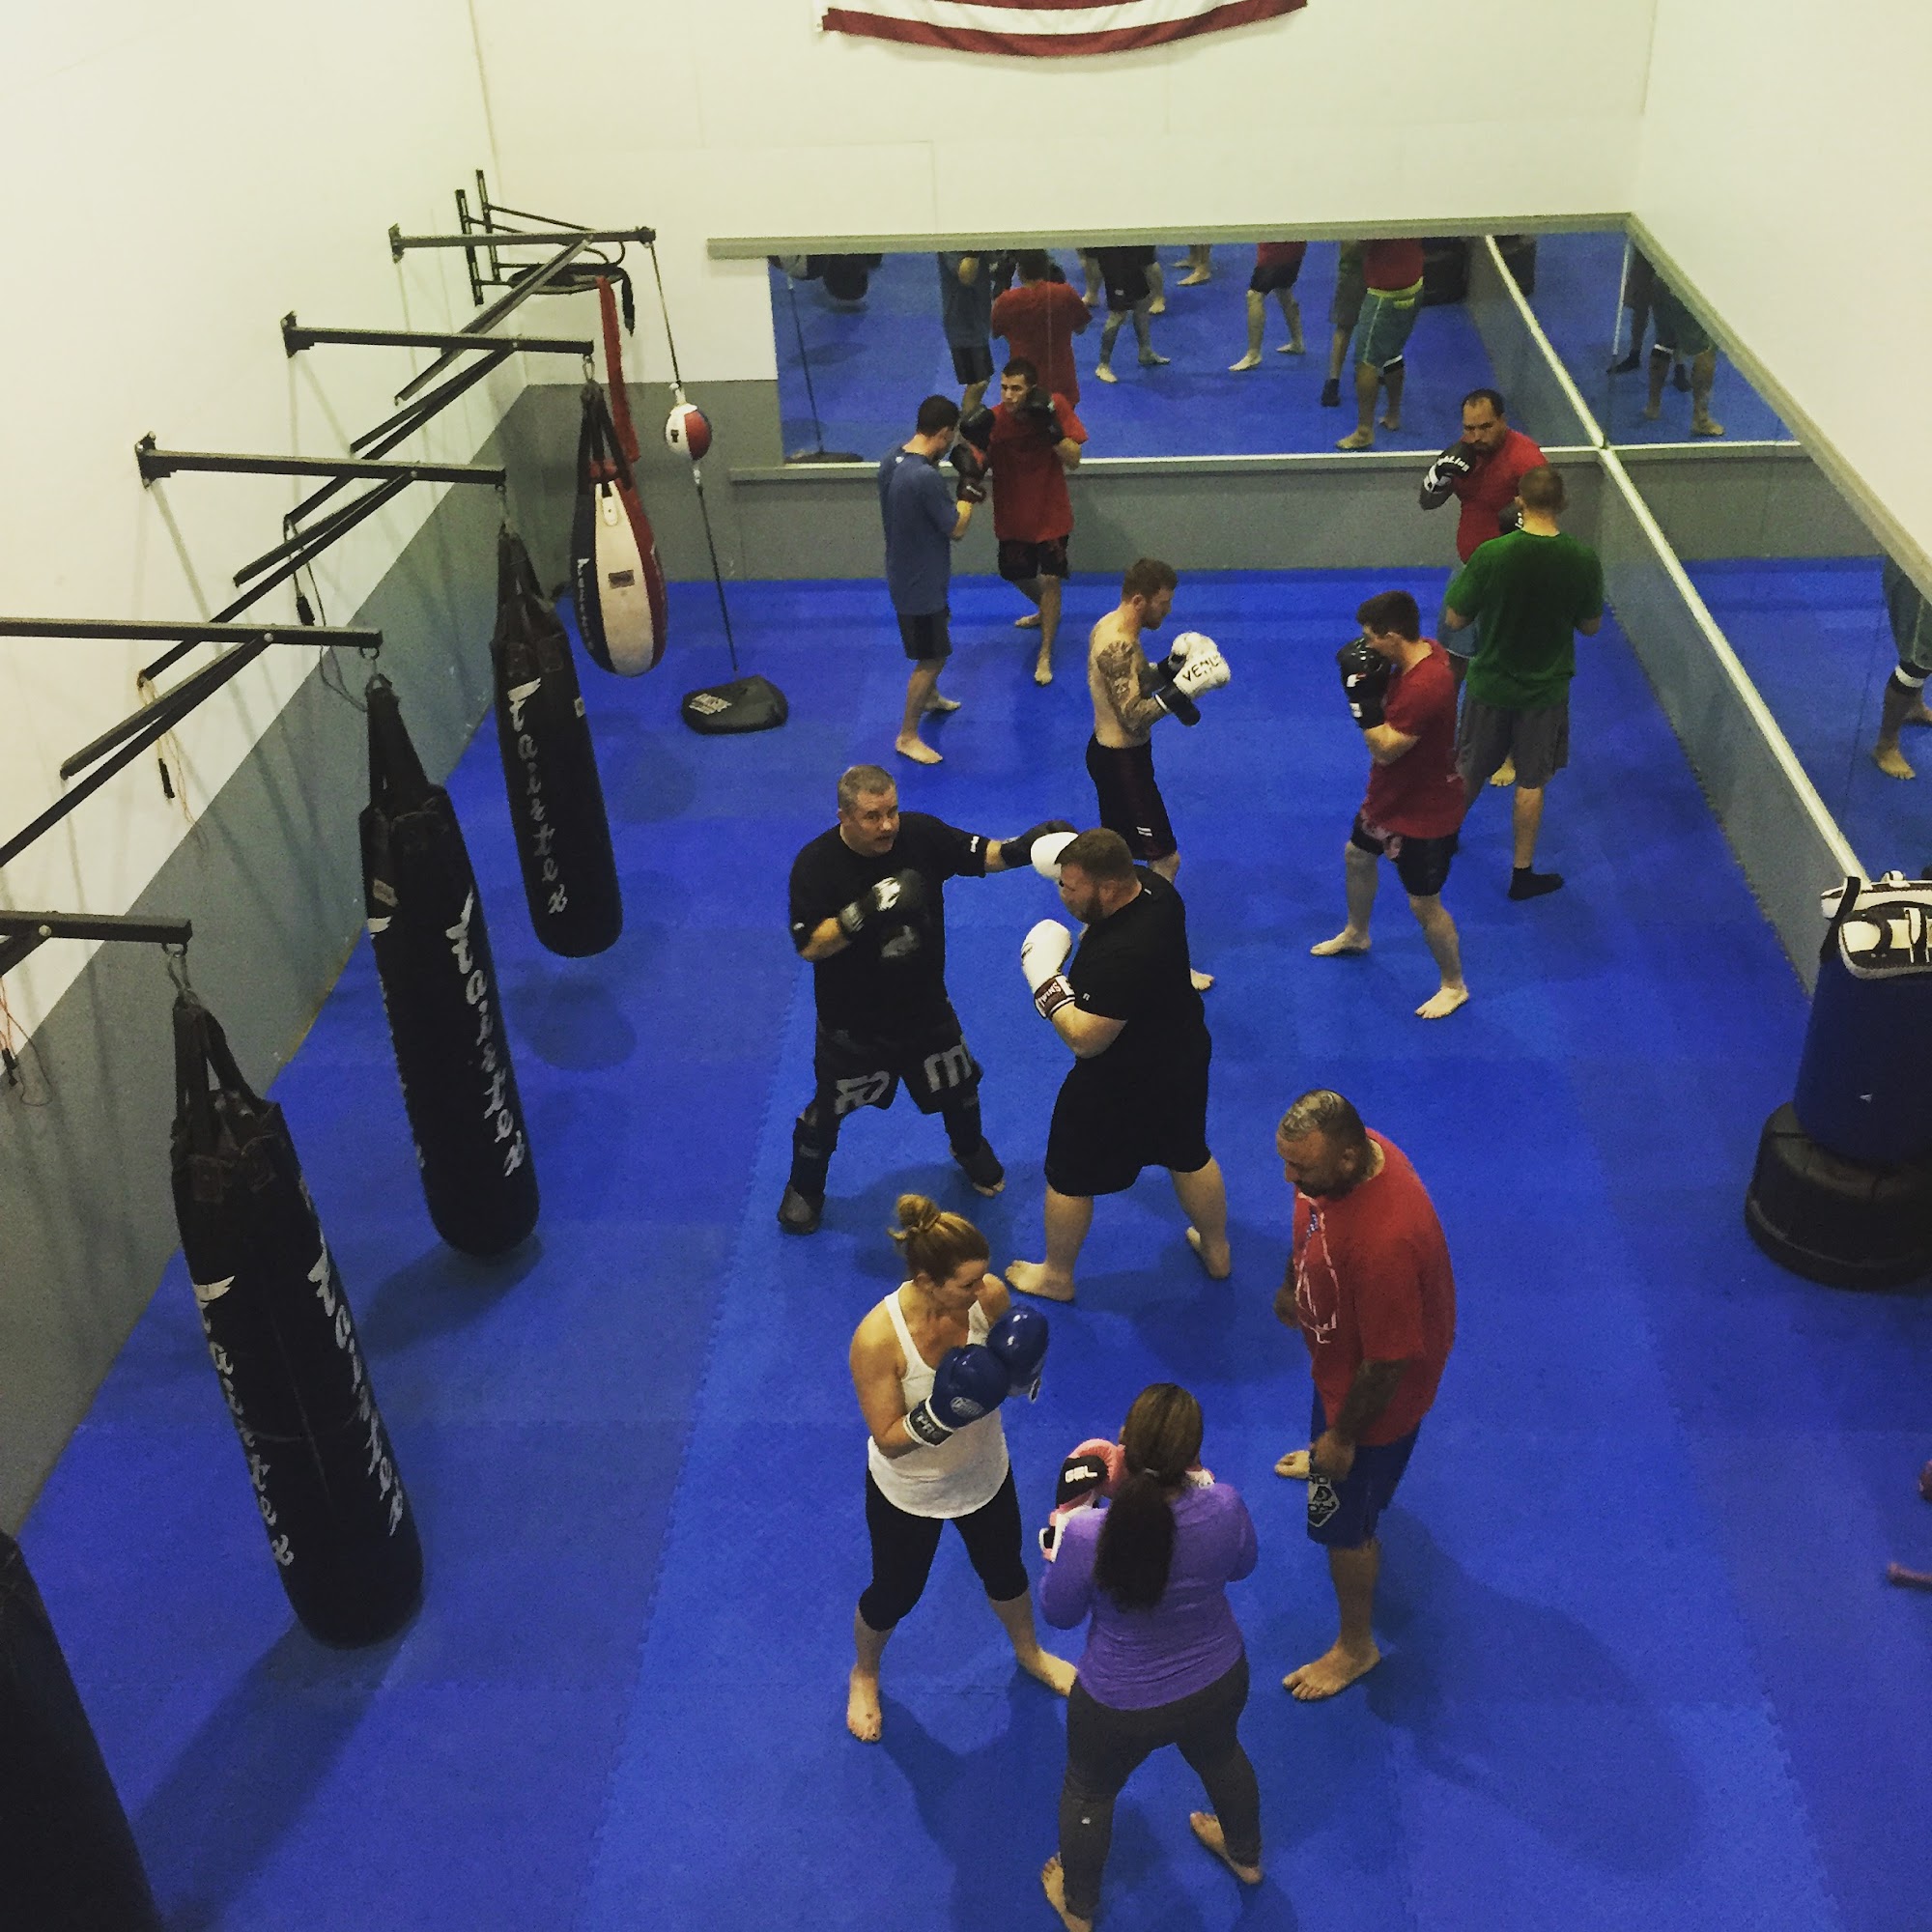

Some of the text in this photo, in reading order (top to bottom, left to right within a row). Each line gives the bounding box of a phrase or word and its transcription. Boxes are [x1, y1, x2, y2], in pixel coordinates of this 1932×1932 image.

[507, 677, 568, 914] Fairtex
[445, 885, 525, 1178] Fairtex
[1065, 1465, 1098, 1484] GEL
